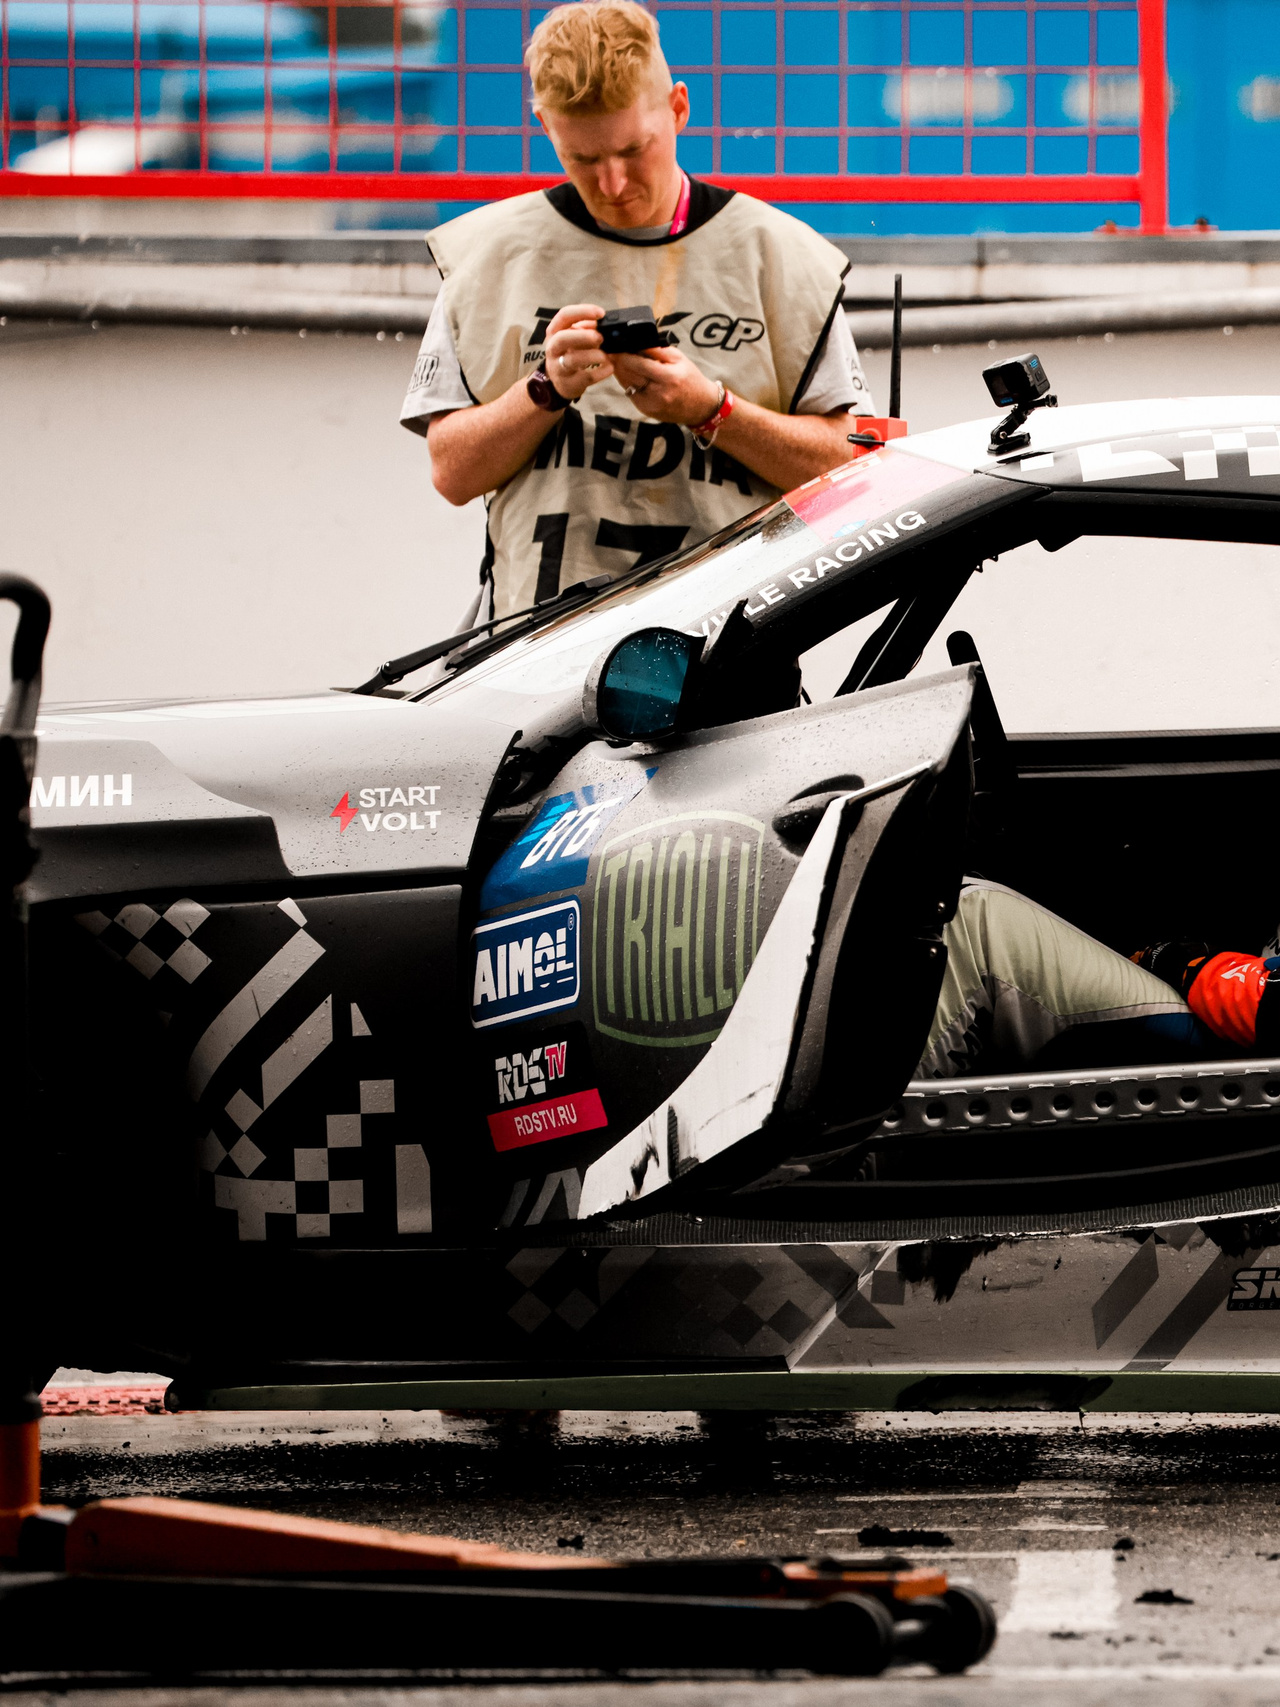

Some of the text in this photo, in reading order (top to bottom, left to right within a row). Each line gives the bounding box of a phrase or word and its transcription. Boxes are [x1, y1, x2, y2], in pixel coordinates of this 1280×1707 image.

[690, 313, 765, 351] GP
[534, 406, 753, 496] MEDIA
[788, 510, 927, 589] RACING
[29, 774, 133, 808] МИН
[358, 785, 441, 808] START
[360, 810, 441, 832] VOLT
[604, 829, 752, 1022] TRIALLI
[473, 927, 575, 1007] AIMOL
[514, 1103, 578, 1136] RDSTV.RU
